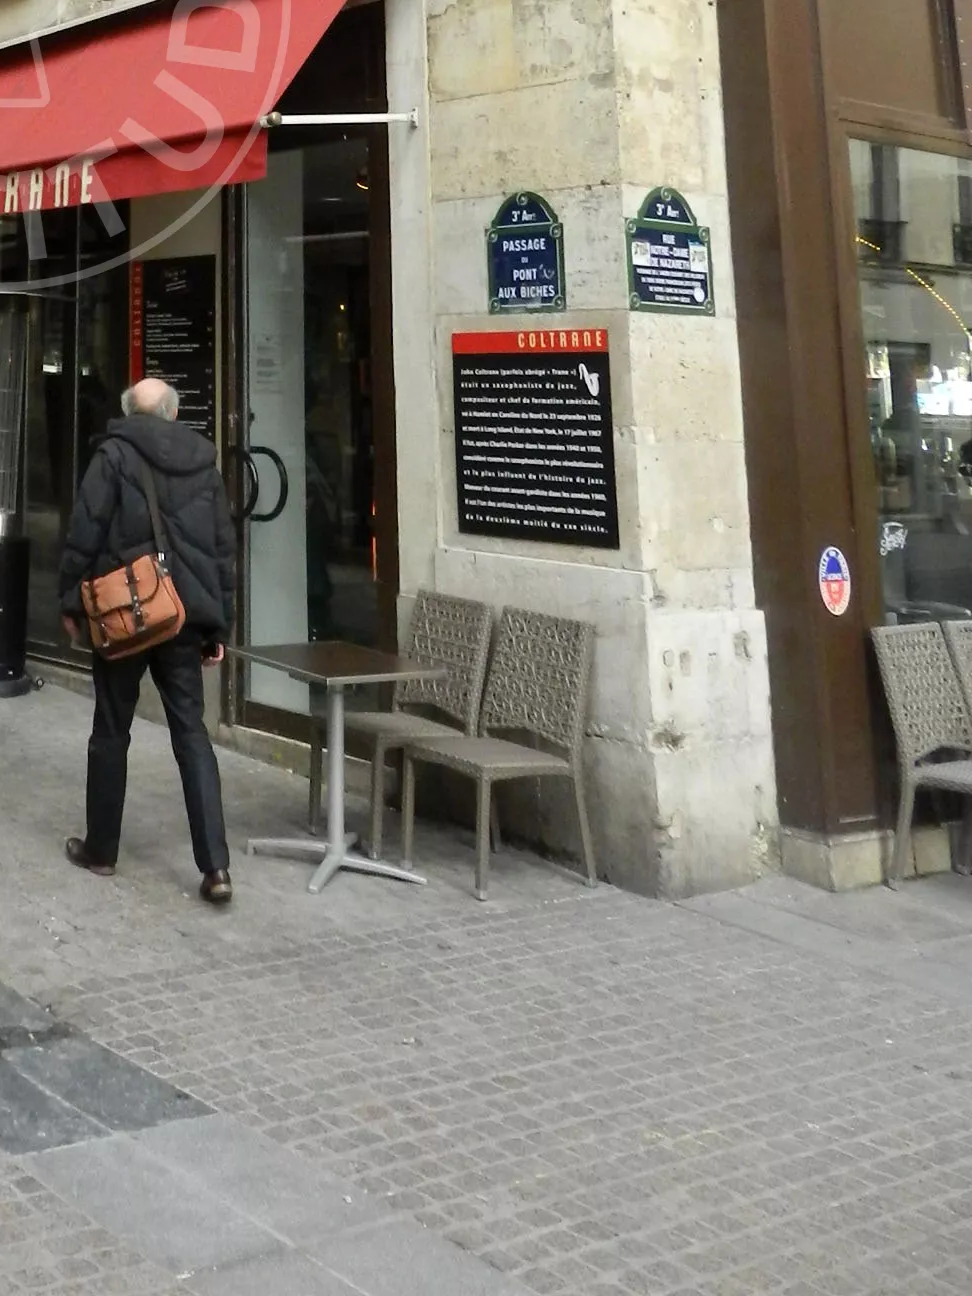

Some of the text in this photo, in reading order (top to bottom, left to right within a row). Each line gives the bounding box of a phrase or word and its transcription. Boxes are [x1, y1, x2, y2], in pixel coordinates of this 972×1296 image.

[502, 238, 546, 252] PASSAGE
[512, 268, 538, 281] PONT
[498, 285, 556, 299] AUX BICHES
[517, 331, 603, 348] COLTRANE
